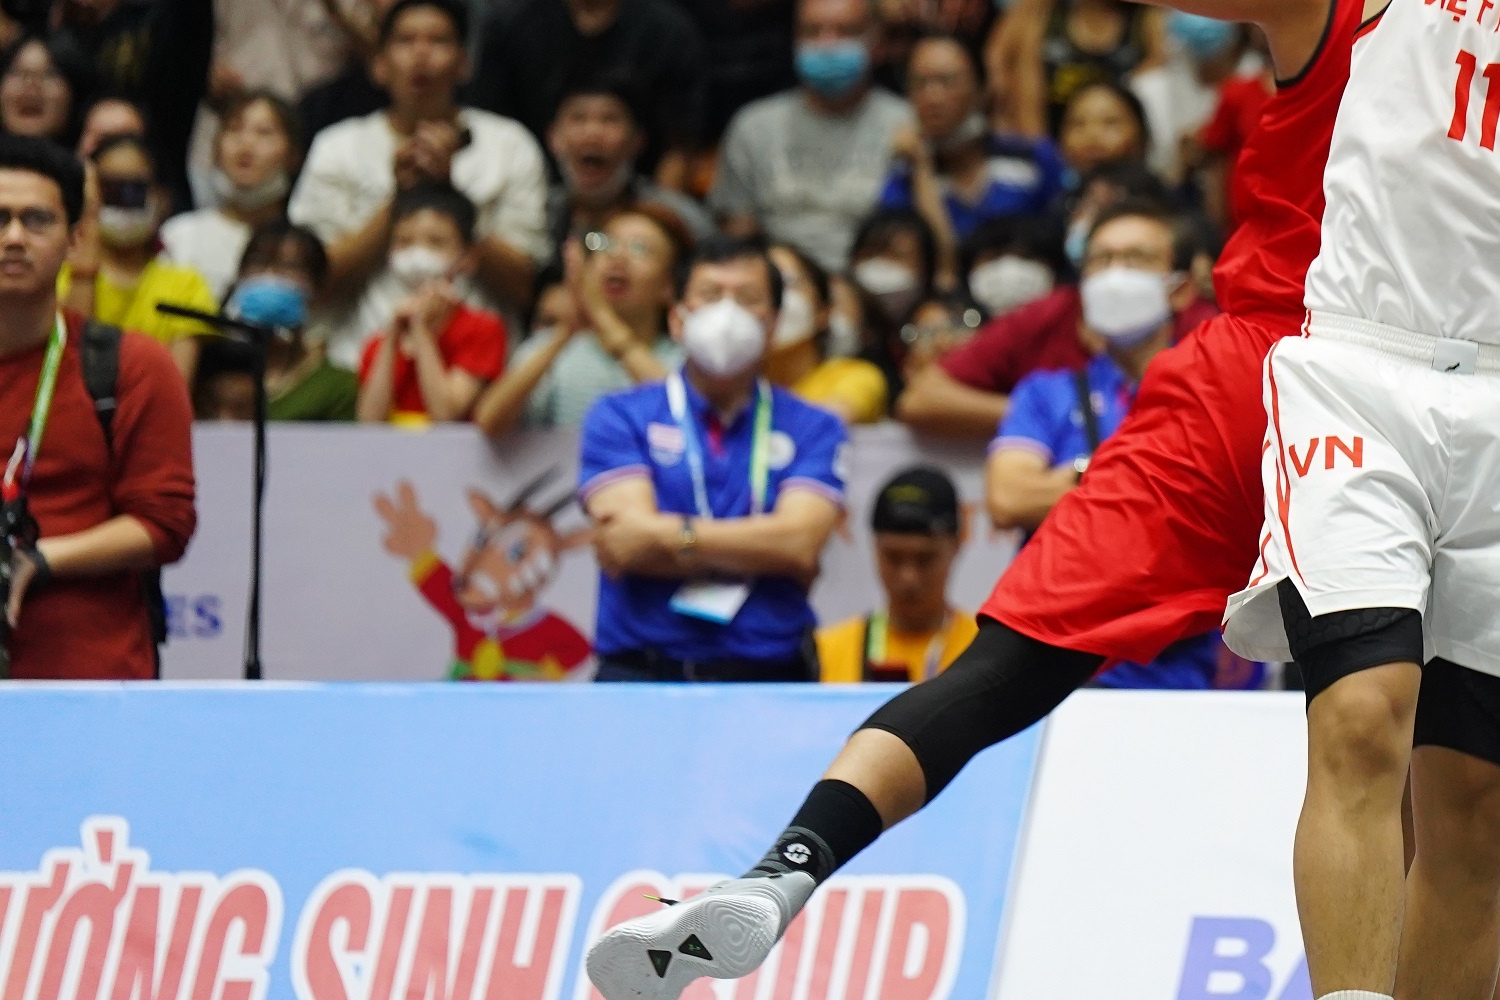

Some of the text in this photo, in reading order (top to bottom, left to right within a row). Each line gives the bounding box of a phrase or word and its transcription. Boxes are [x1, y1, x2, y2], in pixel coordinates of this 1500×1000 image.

[1288, 435, 1363, 478] VN
[304, 883, 568, 1000] SINH
[588, 883, 953, 1000] OUP
